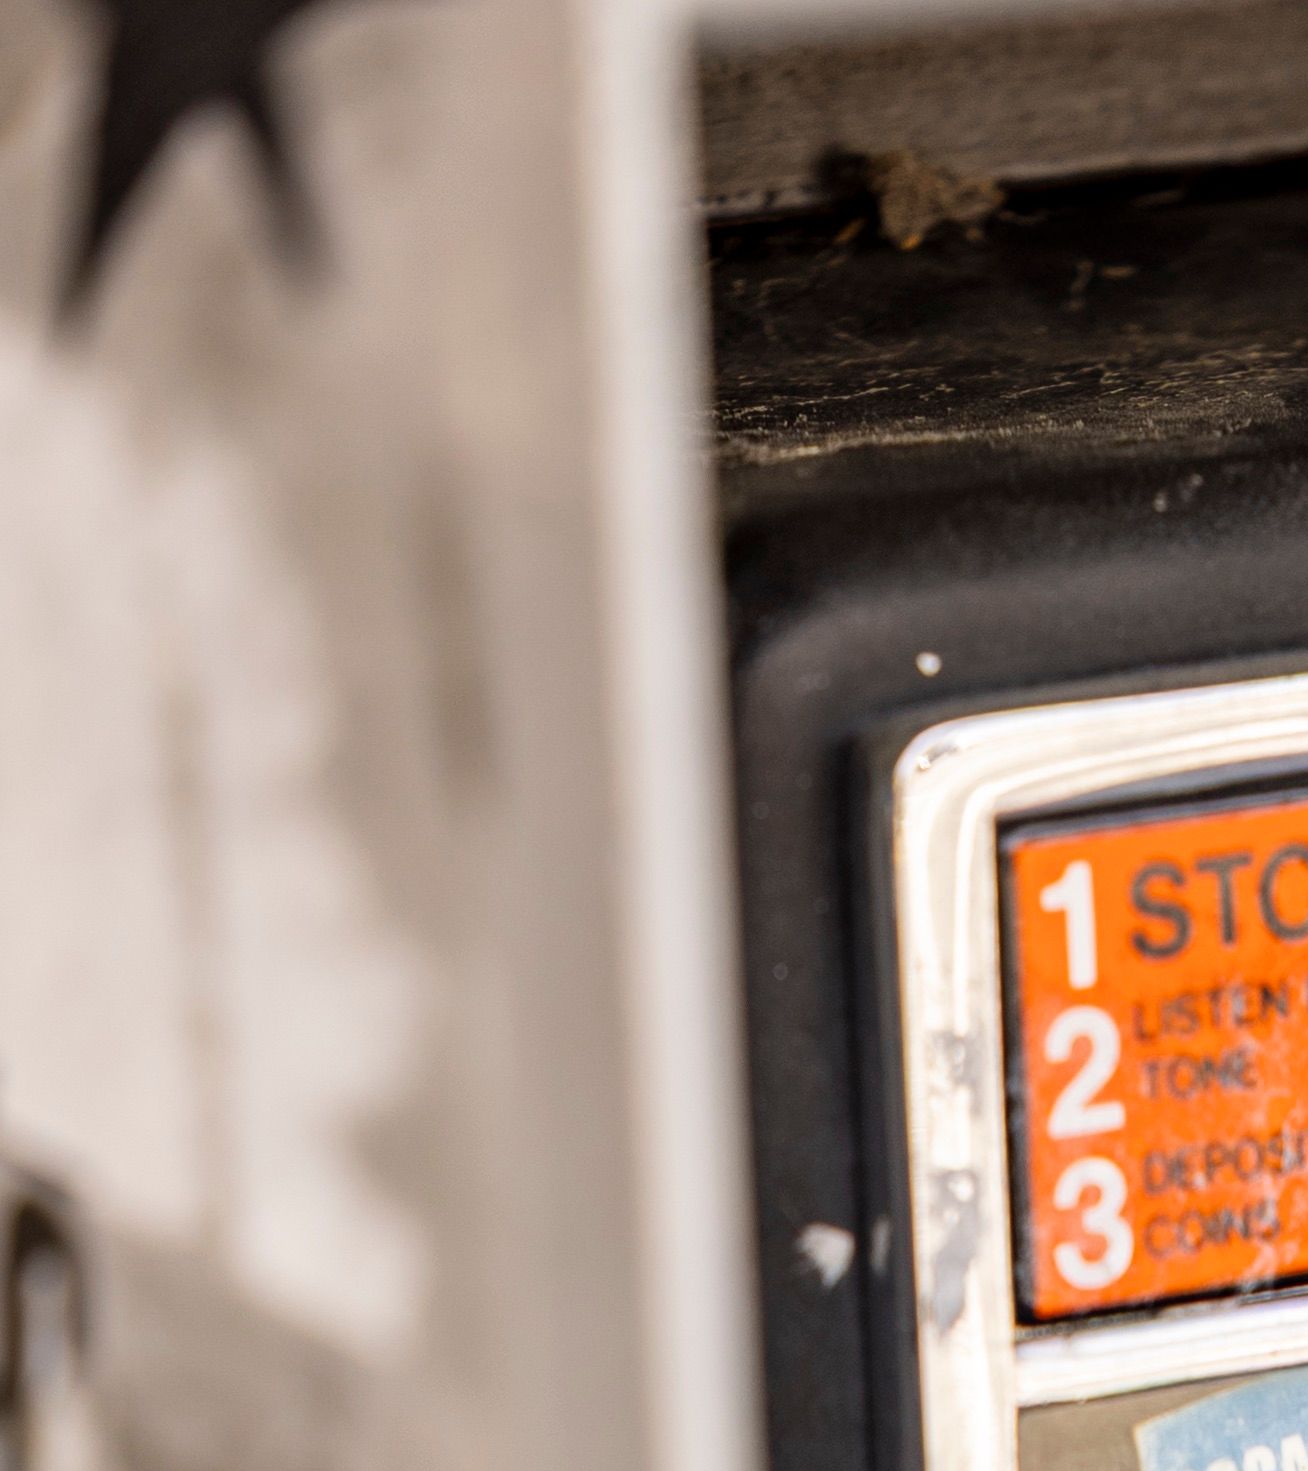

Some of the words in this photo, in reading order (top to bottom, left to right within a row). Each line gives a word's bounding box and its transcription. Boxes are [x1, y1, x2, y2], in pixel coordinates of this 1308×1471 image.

[1040, 860, 1098, 990] 1
[1044, 1006, 1125, 1139] 2
[1135, 977, 1289, 1040] LISTEN
[1144, 1048, 1257, 1101] TONE
[1052, 1157, 1134, 1290] 3
[1144, 1198, 1281, 1261] COINS
